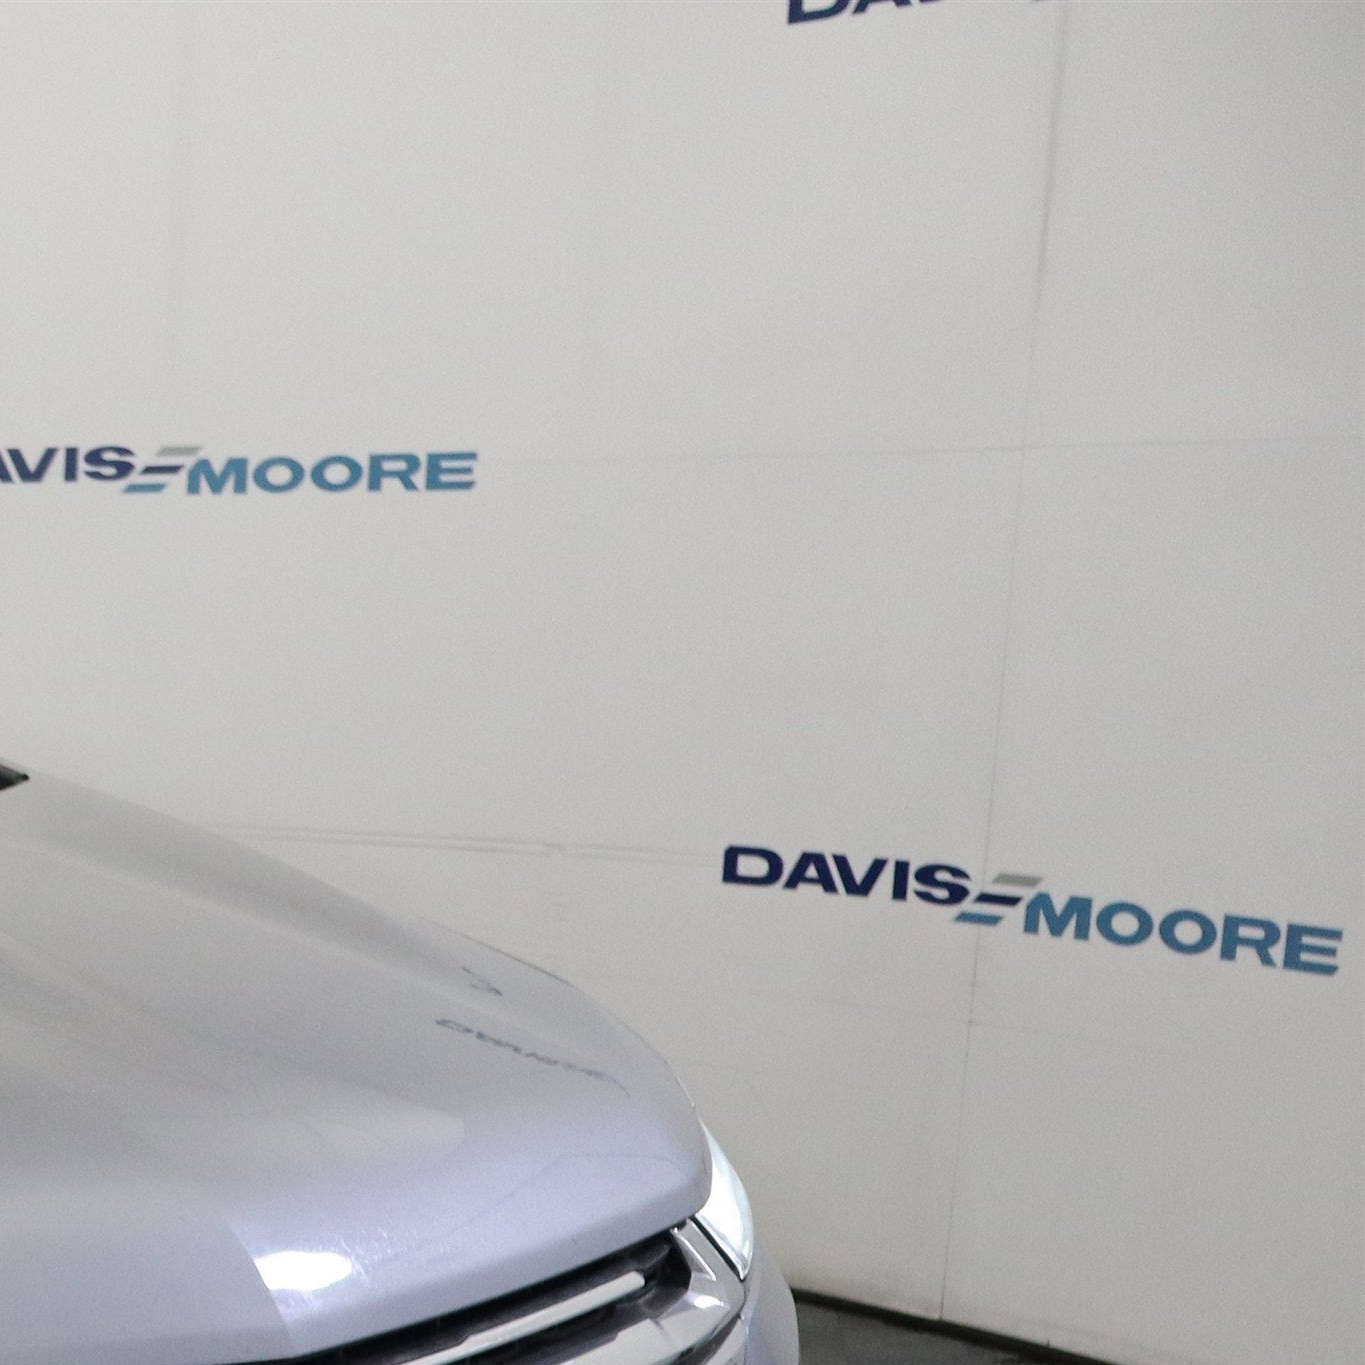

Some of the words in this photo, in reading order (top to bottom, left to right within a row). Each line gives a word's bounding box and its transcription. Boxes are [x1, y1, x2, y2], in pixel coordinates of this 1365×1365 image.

[185, 451, 479, 496] MOORE
[721, 844, 971, 907] DAVIS
[1022, 891, 1345, 978] MOORE
